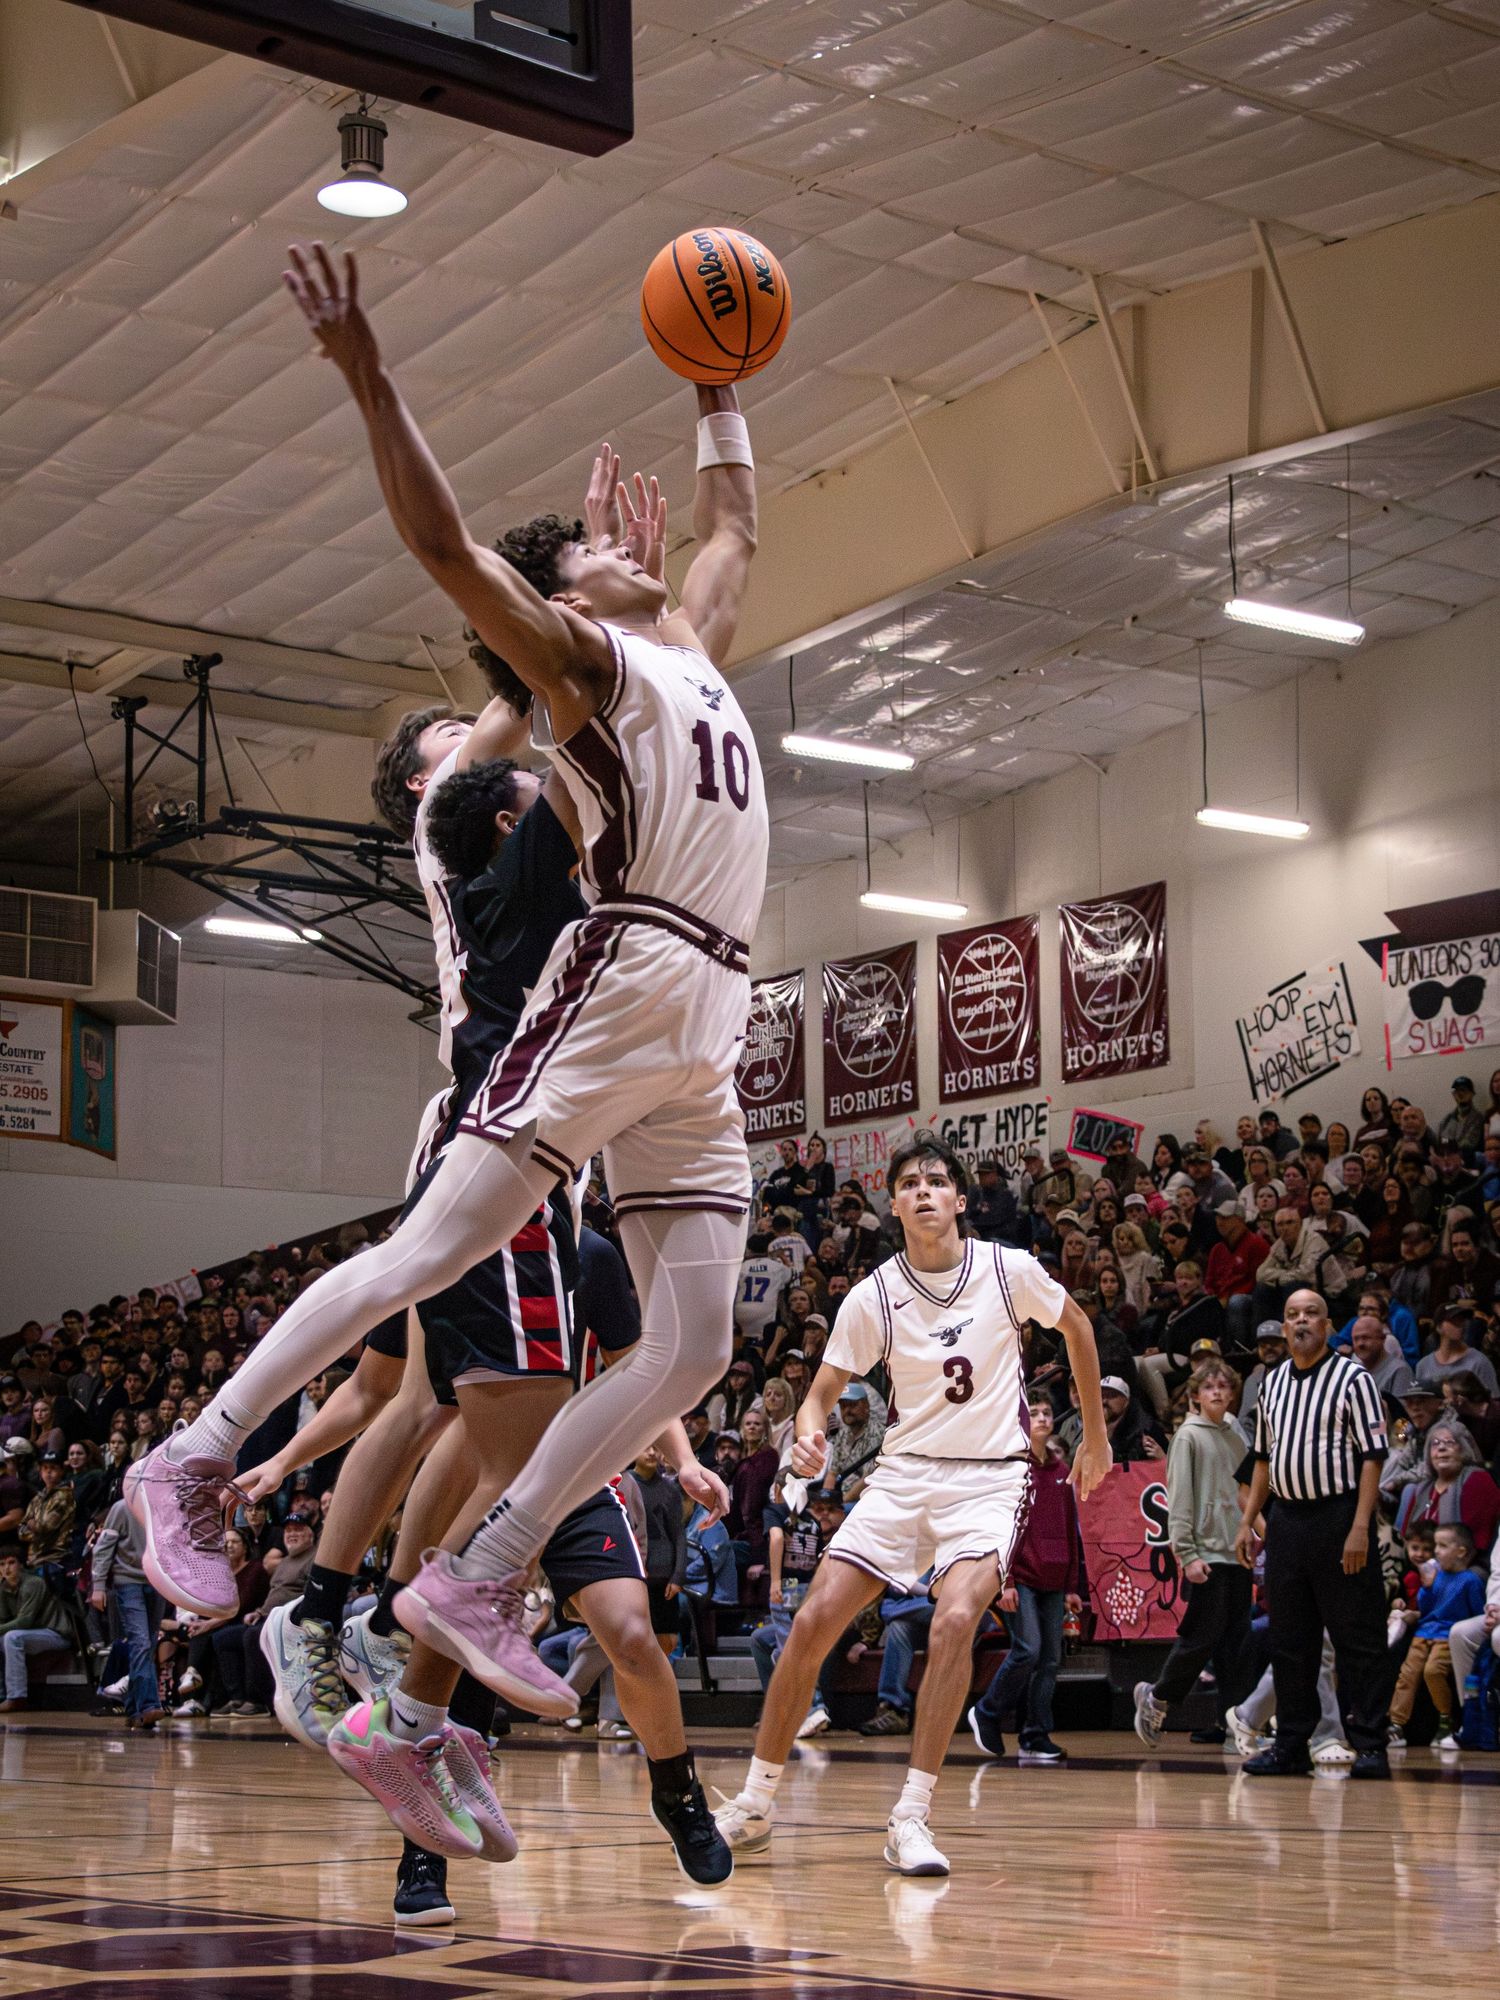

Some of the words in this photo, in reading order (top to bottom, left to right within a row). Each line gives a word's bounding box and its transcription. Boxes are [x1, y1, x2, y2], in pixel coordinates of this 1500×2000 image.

[693, 232, 737, 321] Wilson
[692, 719, 749, 811] 10
[1388, 940, 1472, 988] JUNIORS
[1243, 987, 1301, 1045] HOOP
[1408, 1014, 1484, 1053] SWAG
[1066, 1030, 1165, 1070] HORNETS
[1254, 1022, 1353, 1098] HORNETS
[829, 1080, 914, 1117] HORNETS
[944, 1056, 1036, 1094] HORNETS
[746, 1099, 805, 1133] RNETS
[941, 1113, 987, 1150] GET
[996, 1103, 1048, 1145] HYPE
[742, 1276, 771, 1303] 17
[943, 1356, 974, 1404] 3
